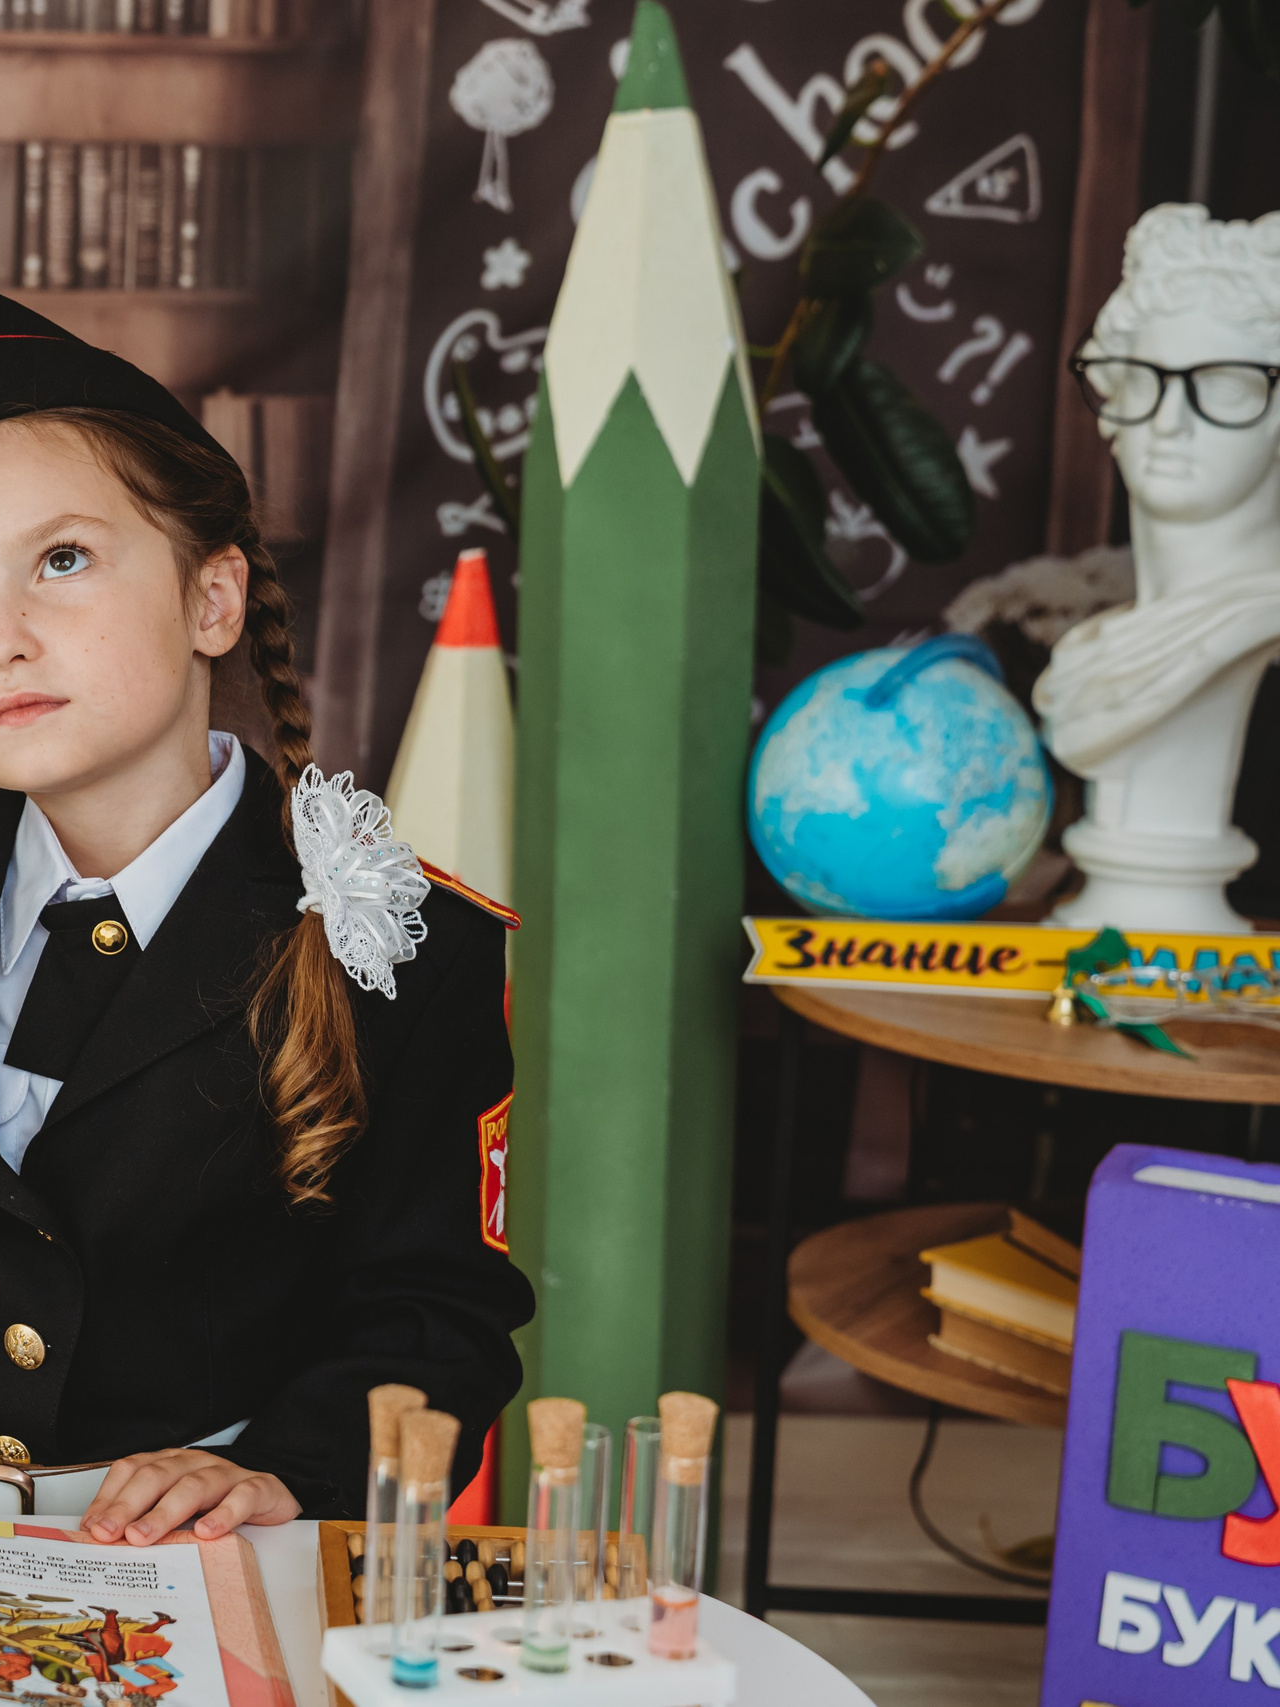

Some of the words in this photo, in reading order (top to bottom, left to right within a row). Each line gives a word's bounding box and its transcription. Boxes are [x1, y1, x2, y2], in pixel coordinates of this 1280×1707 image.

[773, 924, 1029, 976] Знание
[104, 1574, 158, 1582] Люблю
[105, 1580, 159, 1589] Люблю
